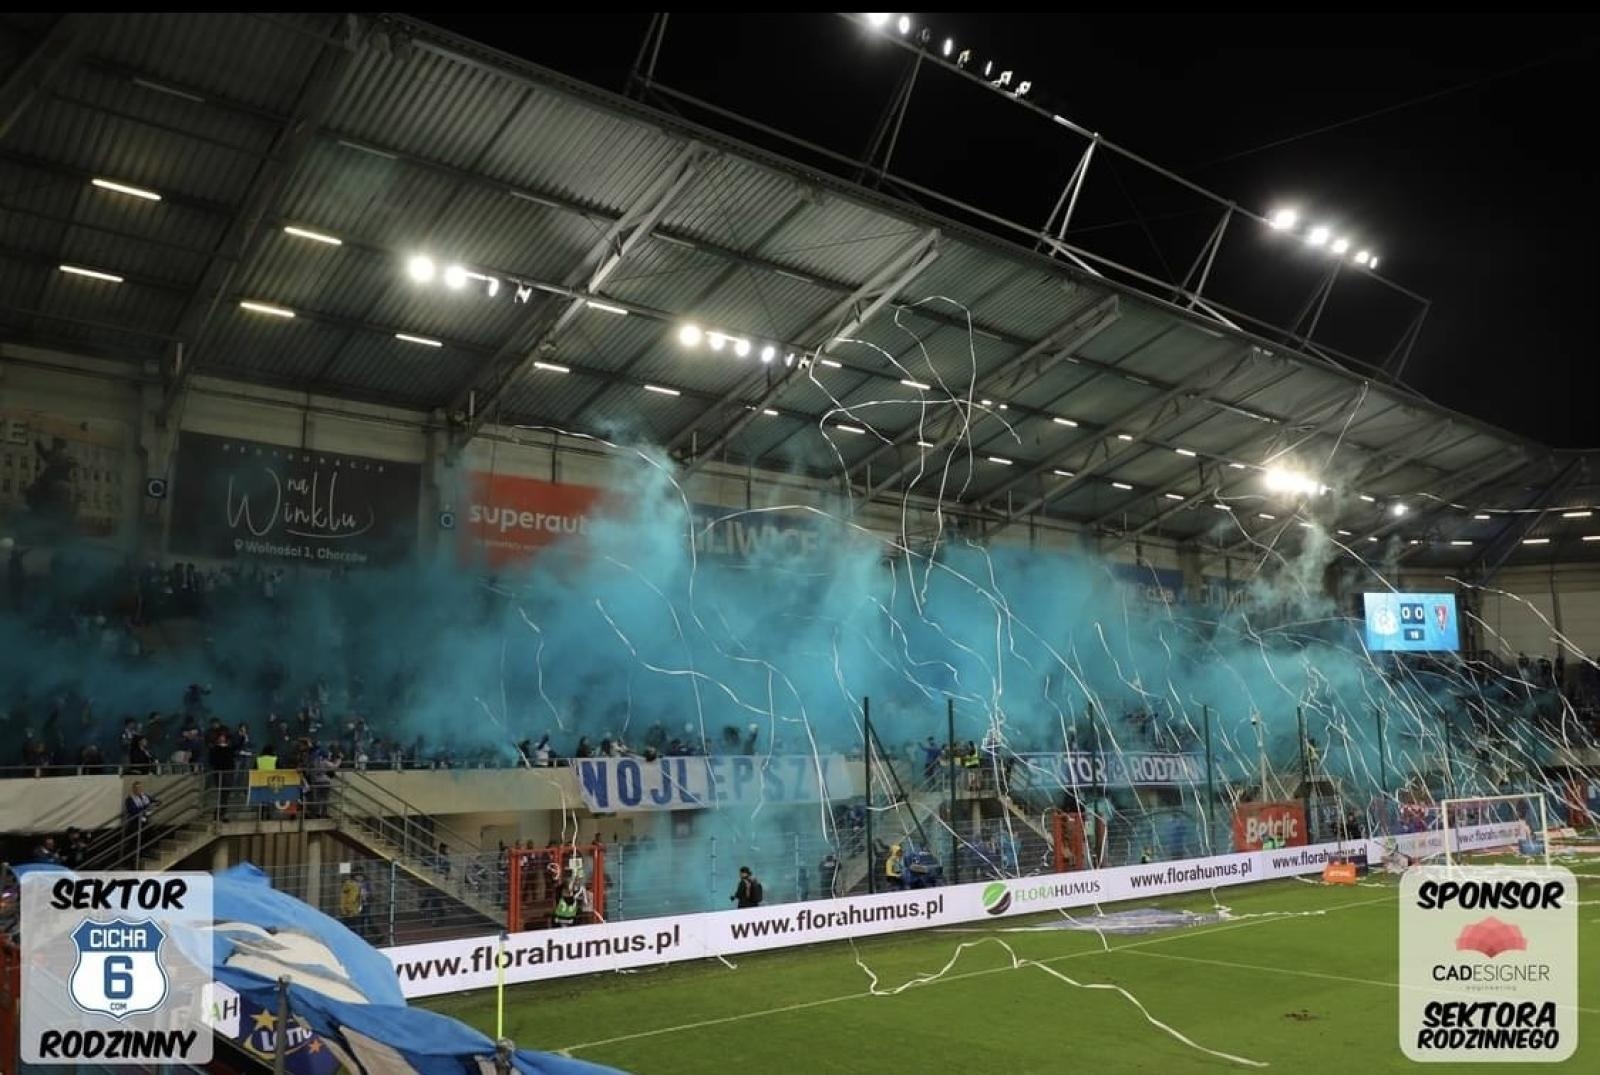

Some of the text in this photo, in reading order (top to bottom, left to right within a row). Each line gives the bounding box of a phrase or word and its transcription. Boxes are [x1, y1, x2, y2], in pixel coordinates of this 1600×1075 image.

[227, 466, 360, 536] Winklu
[287, 478, 311, 495] na
[469, 504, 592, 534] superaut
[1131, 857, 1253, 889] www.florahumus.pl
[1015, 880, 1101, 902] FLORAHUMUS
[731, 894, 944, 940] www.florahumus.pl
